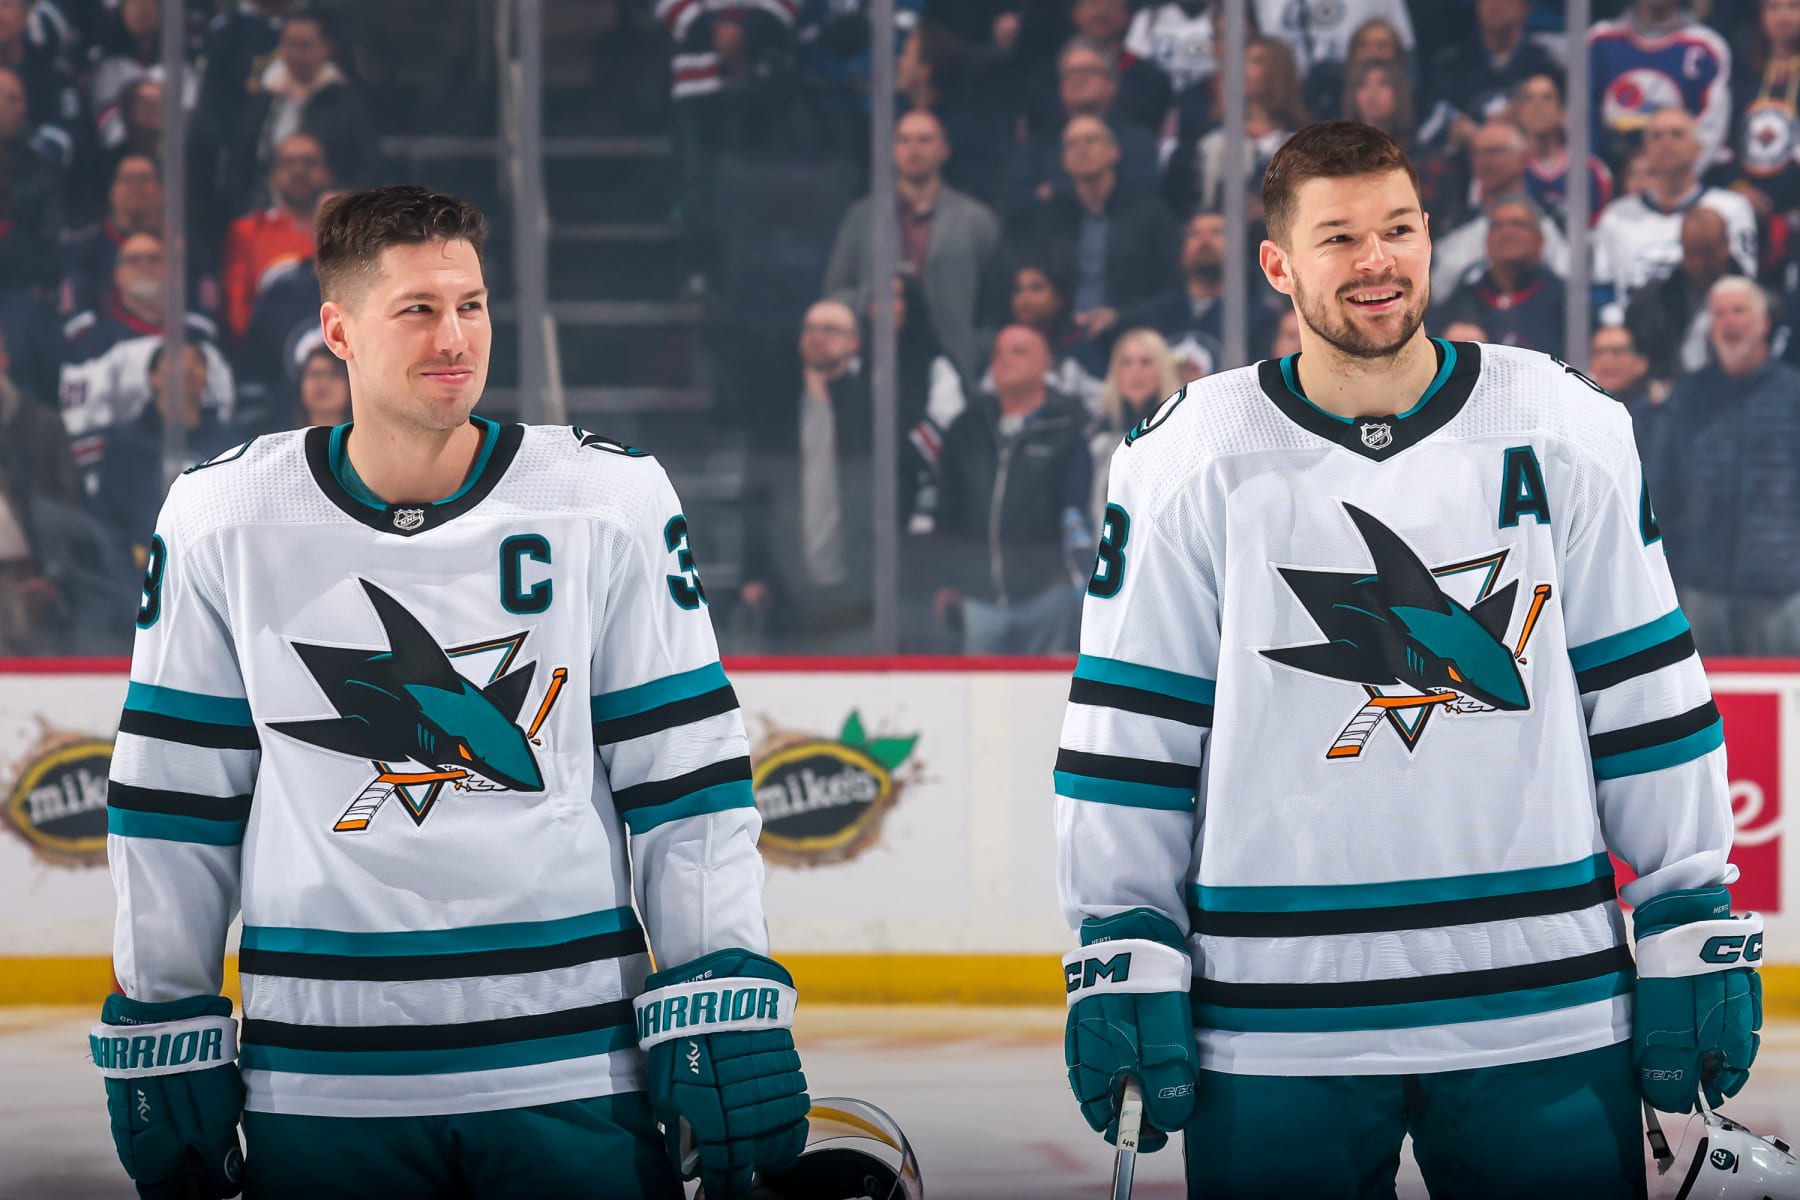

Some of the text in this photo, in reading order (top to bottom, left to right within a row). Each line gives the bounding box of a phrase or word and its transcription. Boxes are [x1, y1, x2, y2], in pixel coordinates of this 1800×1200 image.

[1499, 445, 1551, 529] A
[500, 533, 552, 615] C
[1712, 1150, 1728, 1167] 27
